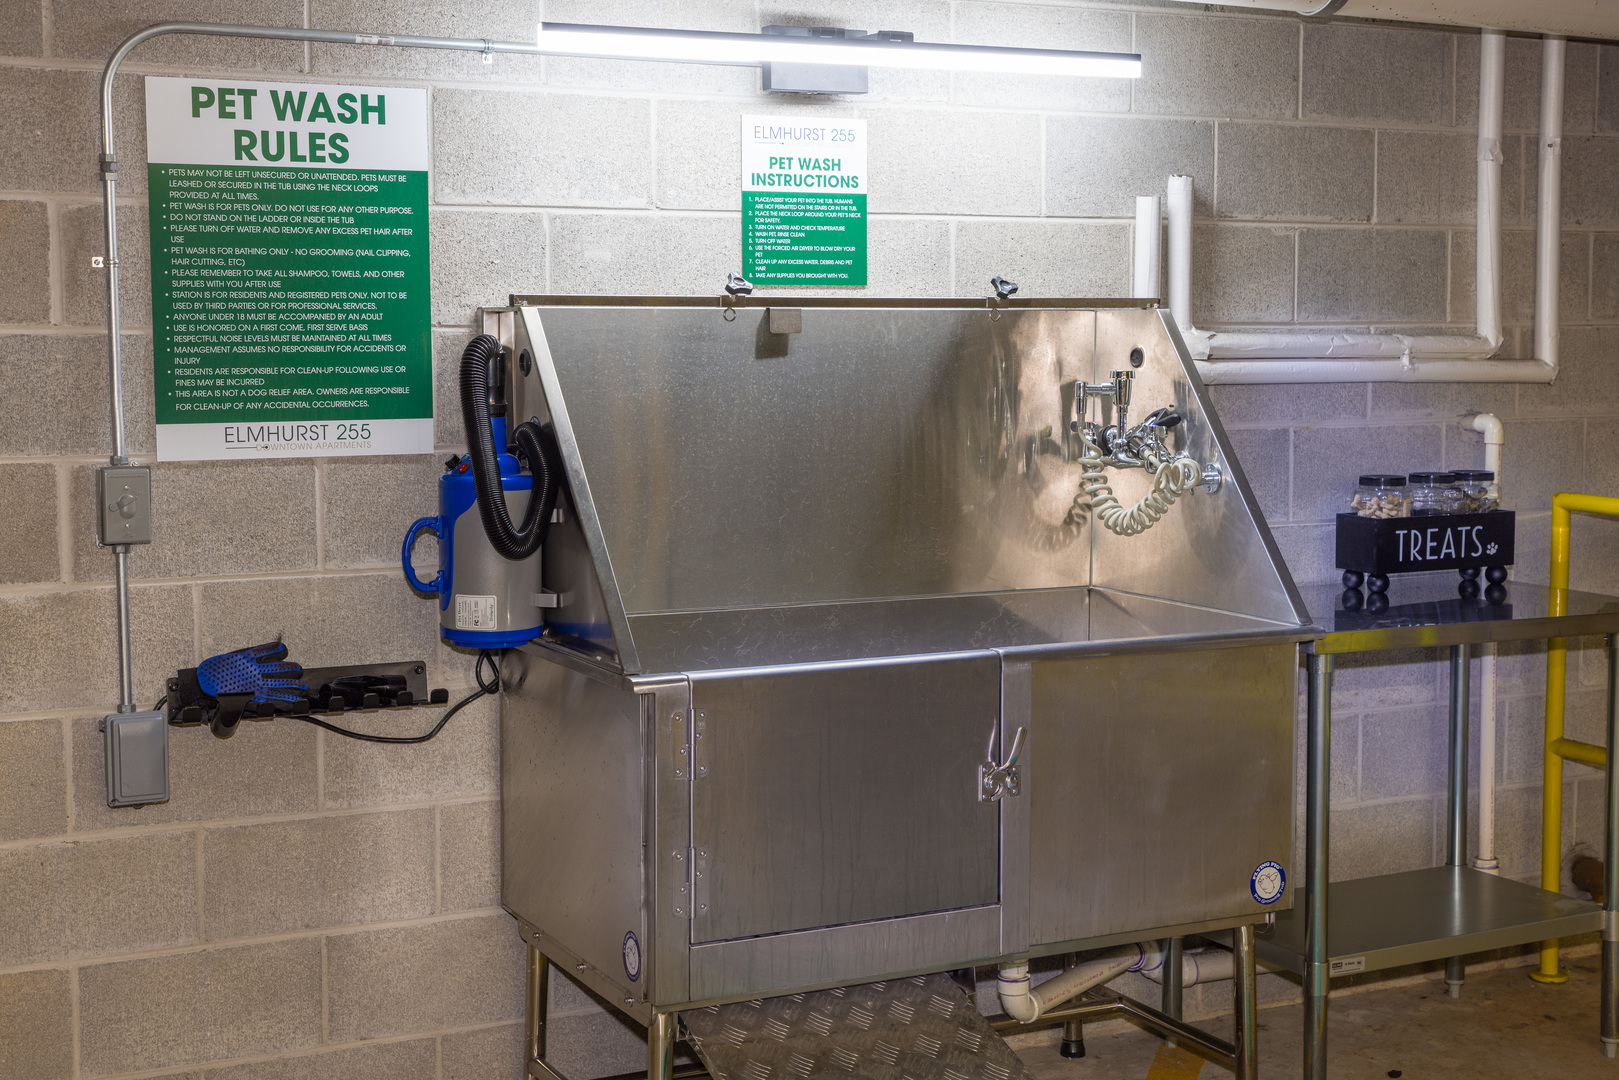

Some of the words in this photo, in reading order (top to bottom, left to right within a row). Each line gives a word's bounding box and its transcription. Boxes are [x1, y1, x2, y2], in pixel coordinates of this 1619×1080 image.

[191, 86, 257, 120] PET
[270, 90, 385, 125] WASH
[755, 126, 826, 140] ELMHURST
[831, 129, 855, 142] 255
[234, 130, 349, 164] RULES
[770, 157, 793, 170] PET
[798, 158, 841, 171] WASH
[186, 169, 204, 177] MAY
[251, 171, 296, 179] UNSECURED
[752, 173, 859, 188] INSTRUCTIONS
[169, 191, 209, 199] PROVIDED
[183, 202, 206, 210] WASH
[192, 402, 231, 410] CLEAN-UP
[263, 401, 310, 409] ACCIDENTAL
[225, 425, 329, 443] ELMHURST
[336, 424, 371, 440] 255
[316, 441, 371, 450] APARTMENTS
[1396, 526, 1483, 562] TREATS
